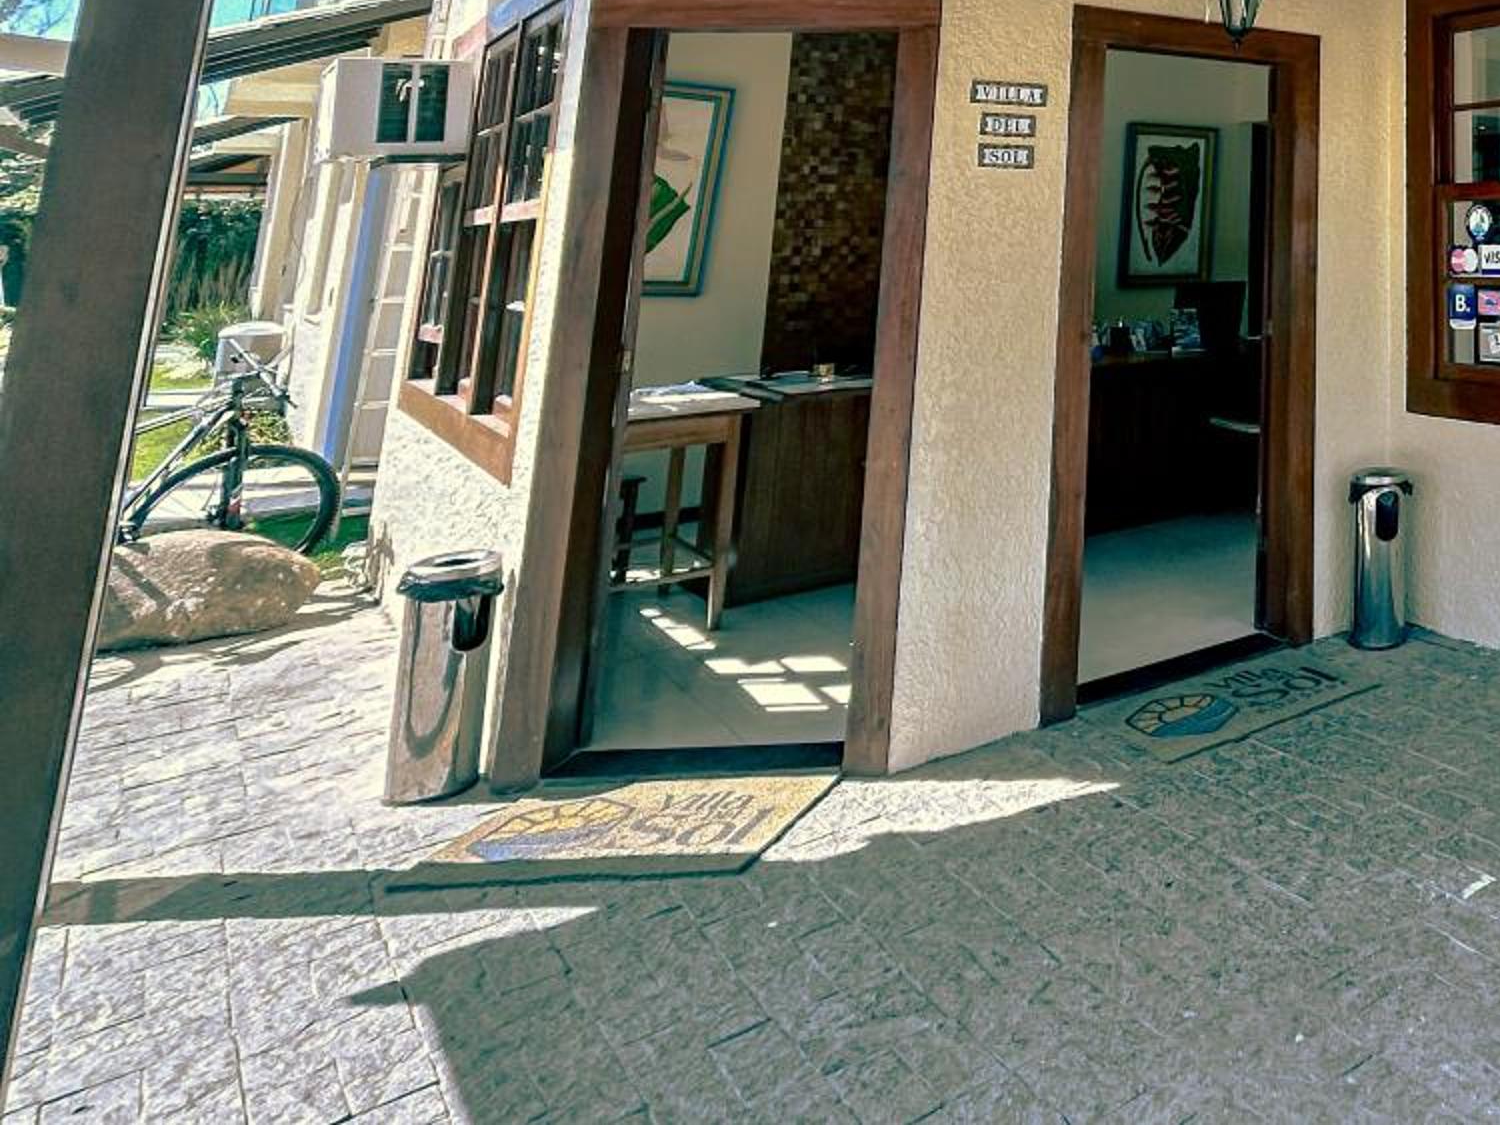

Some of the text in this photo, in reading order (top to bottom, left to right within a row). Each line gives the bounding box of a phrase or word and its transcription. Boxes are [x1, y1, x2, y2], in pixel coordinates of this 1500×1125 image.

[983, 86, 1035, 102] VILLA
[989, 150, 1023, 164] SOL
[658, 790, 755, 812] Villa
[630, 806, 775, 847] Sol
